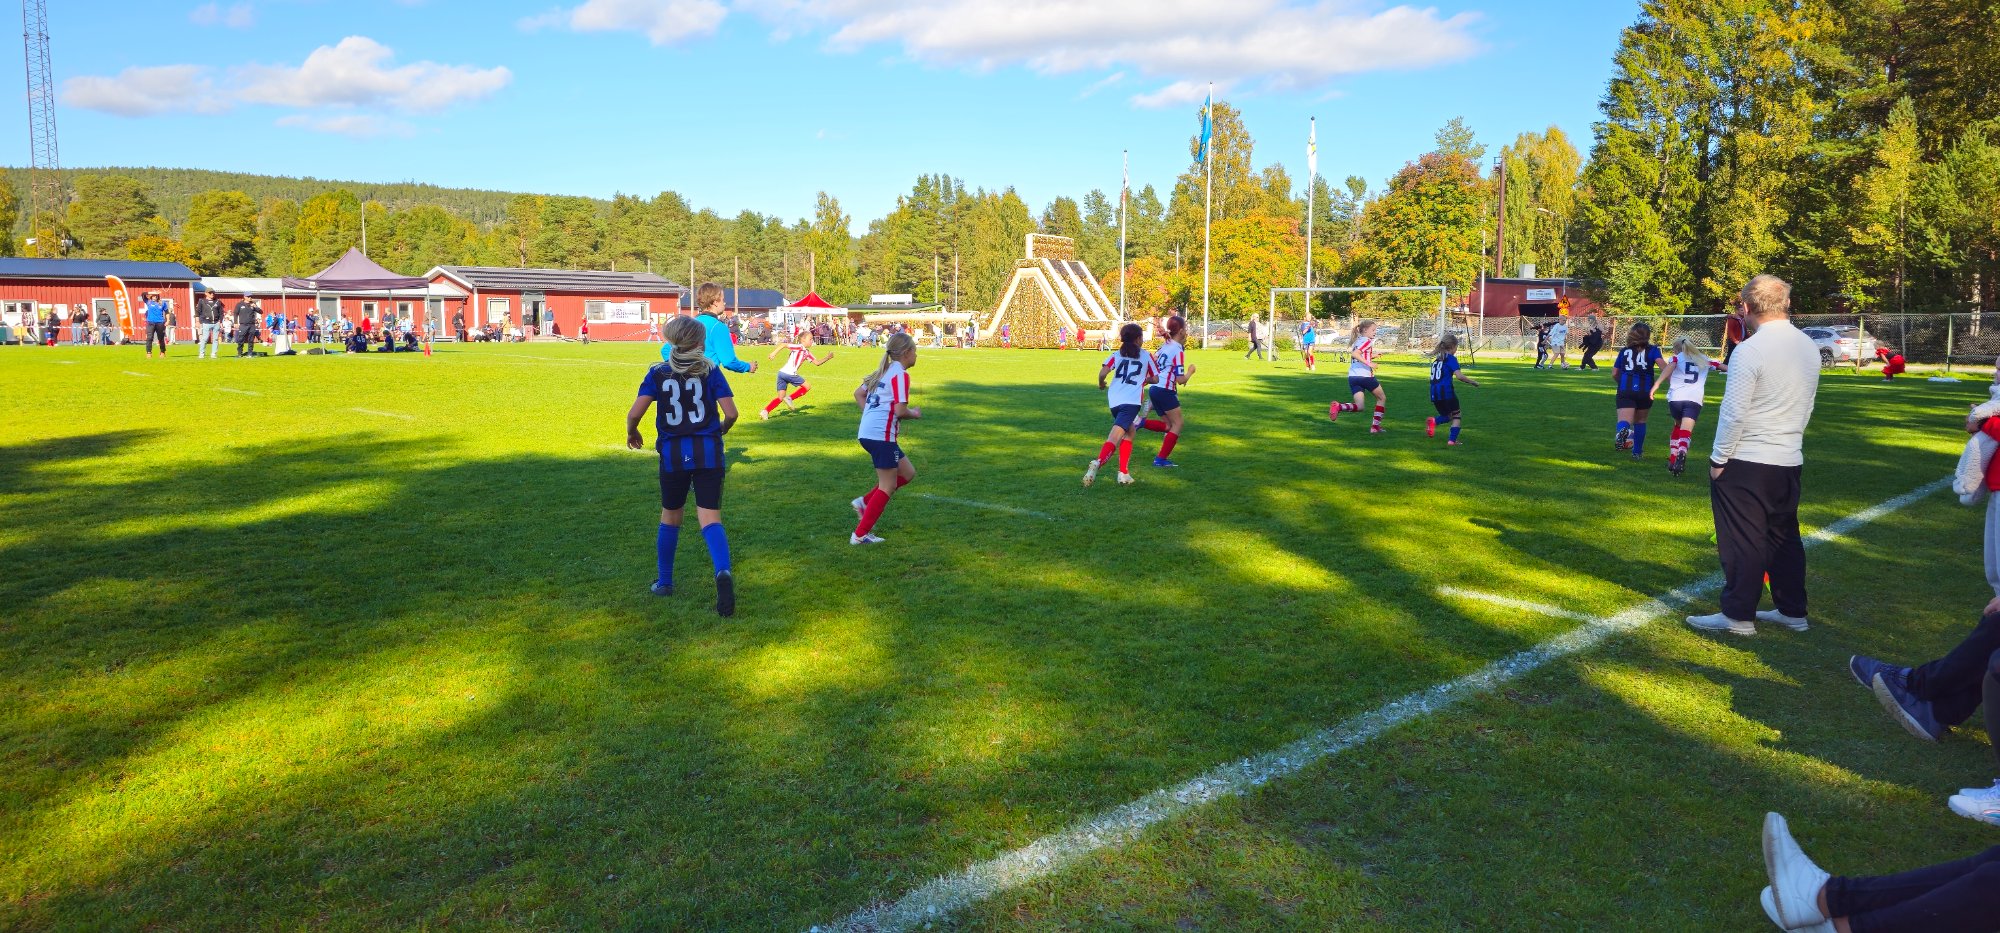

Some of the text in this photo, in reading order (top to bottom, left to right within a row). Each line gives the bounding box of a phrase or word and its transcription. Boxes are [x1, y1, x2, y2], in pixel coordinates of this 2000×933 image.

[1623, 348, 1648, 371] 34
[1115, 359, 1143, 386] 42
[1683, 361, 1699, 384] 5
[662, 377, 706, 426] 33
